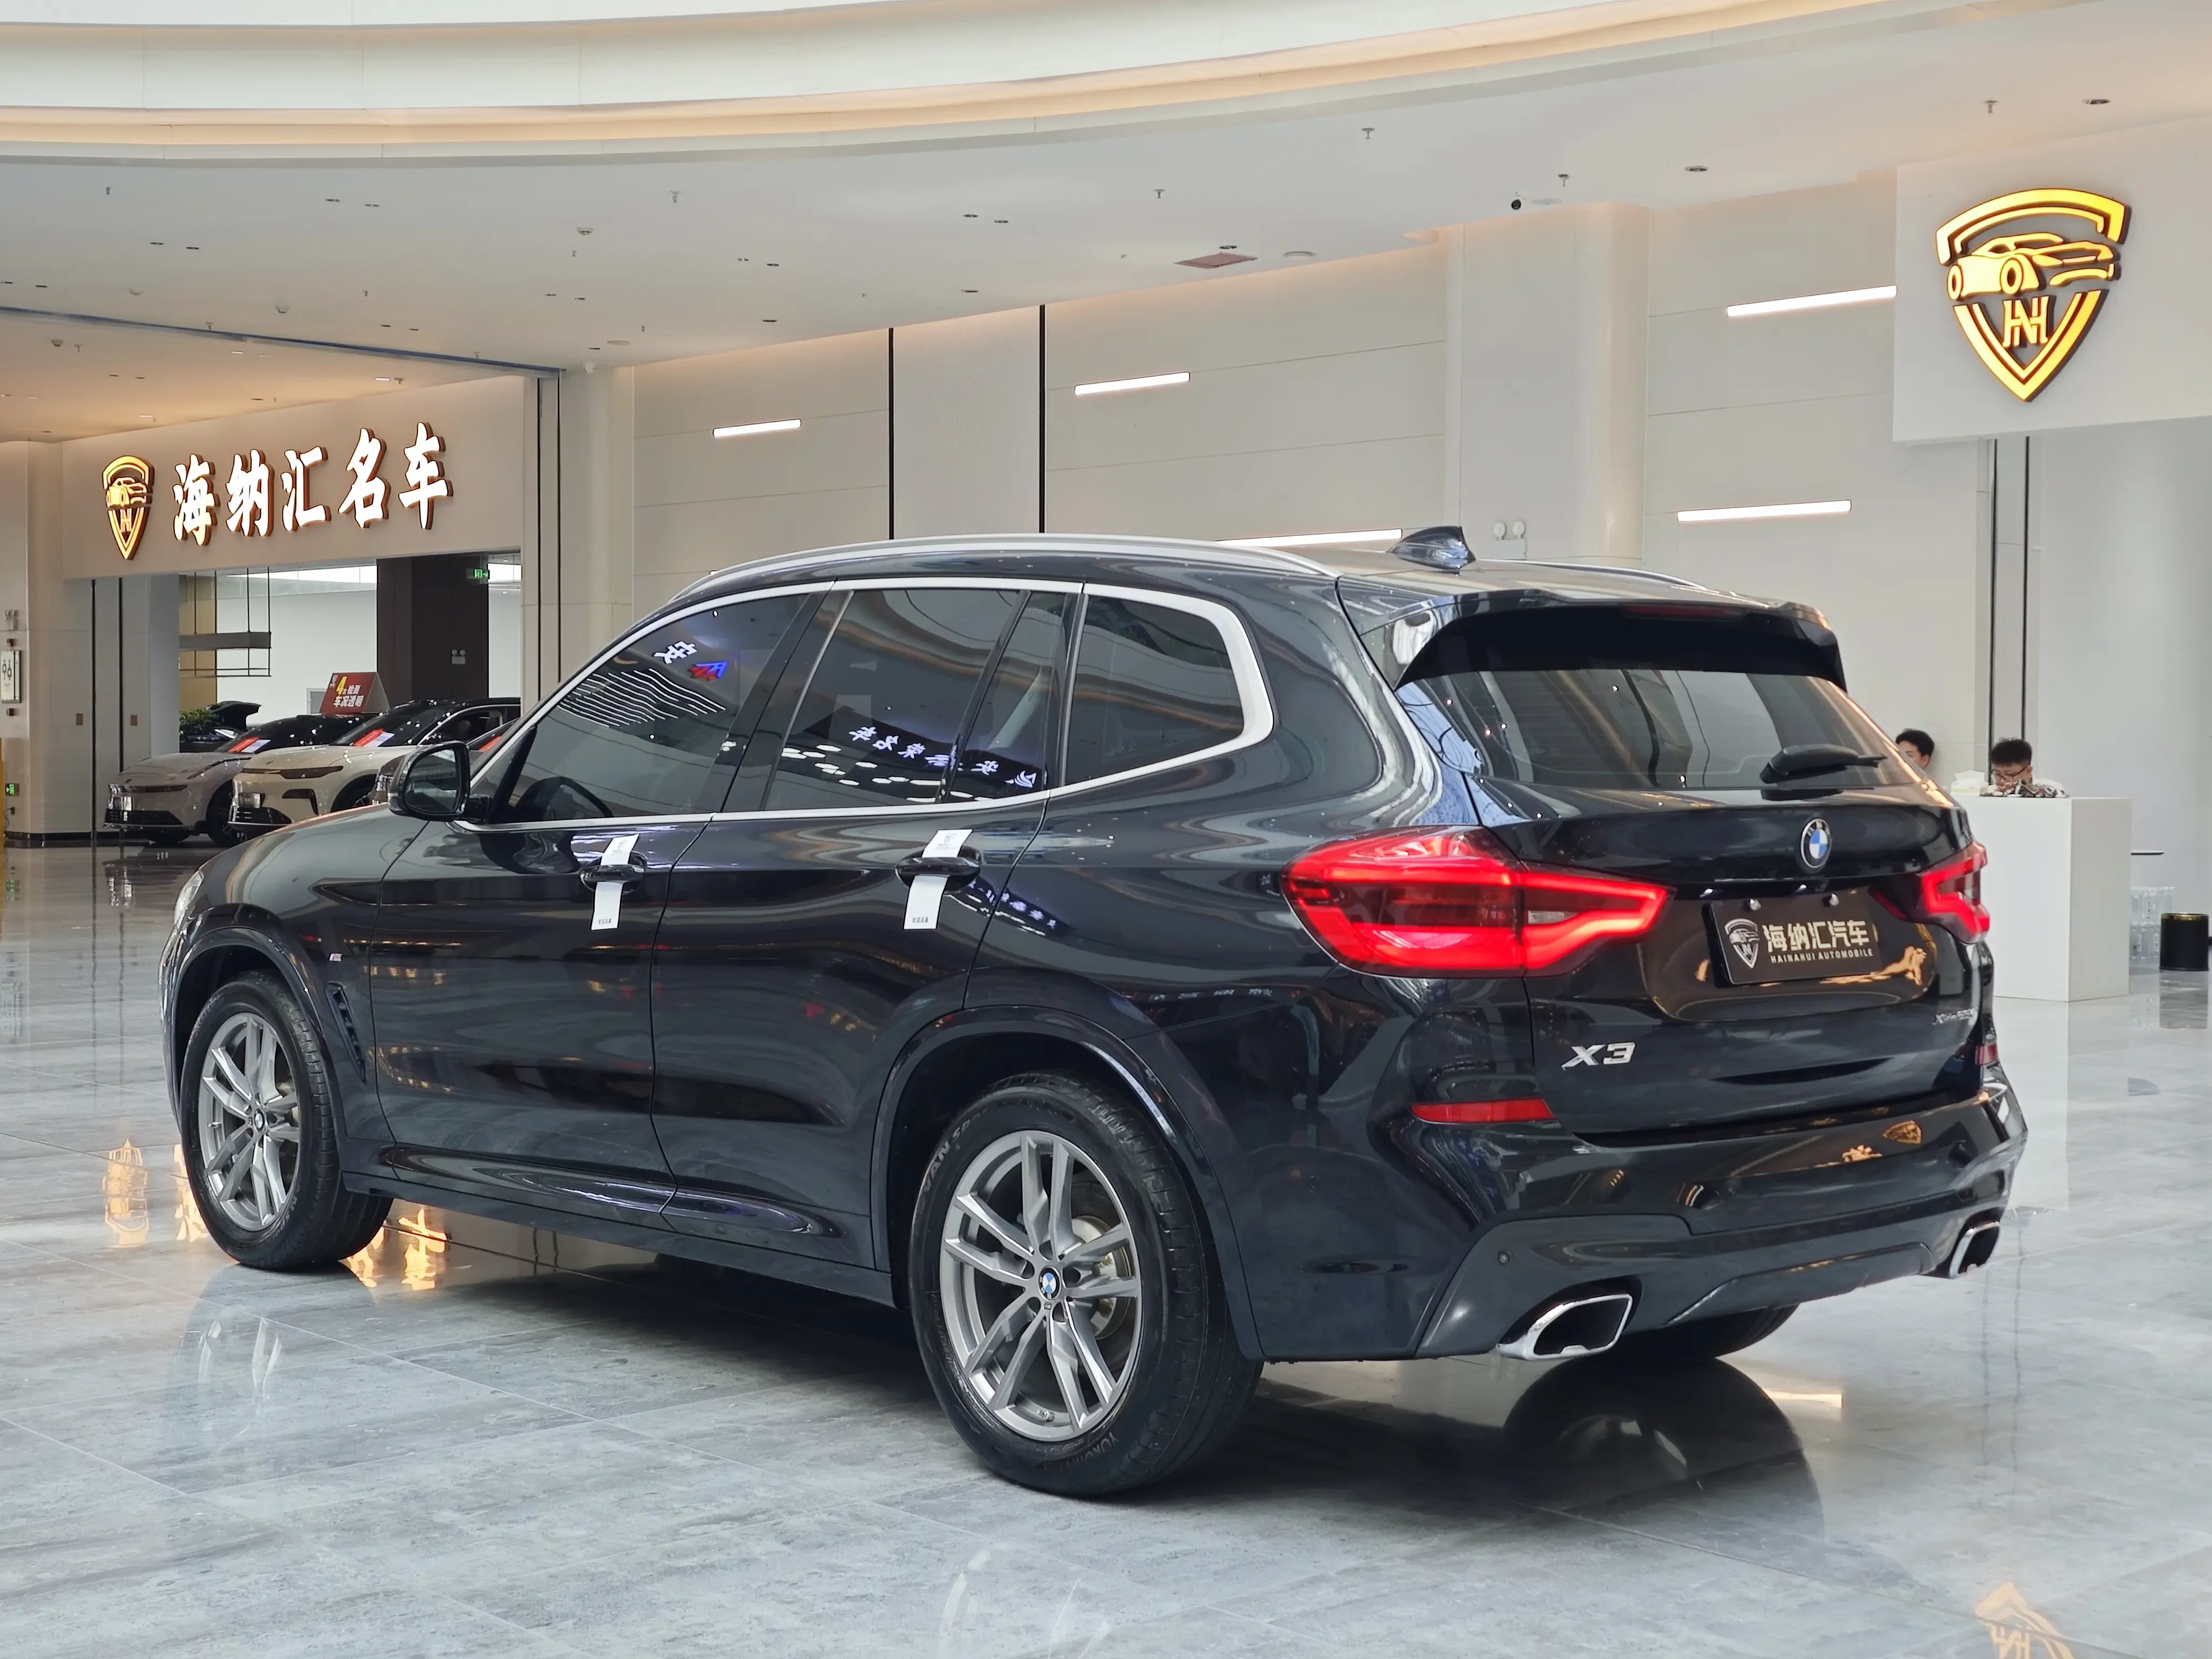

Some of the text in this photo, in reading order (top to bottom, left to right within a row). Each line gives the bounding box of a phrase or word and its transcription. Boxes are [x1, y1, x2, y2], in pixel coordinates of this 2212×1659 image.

[173, 422, 451, 545] 海纳汇名车
[1762, 920, 1870, 953] 海纳汇汽车
[1770, 948, 1873, 963] HAINAHUI AUTOMOBILE
[1561, 1042, 1636, 1069] X3
